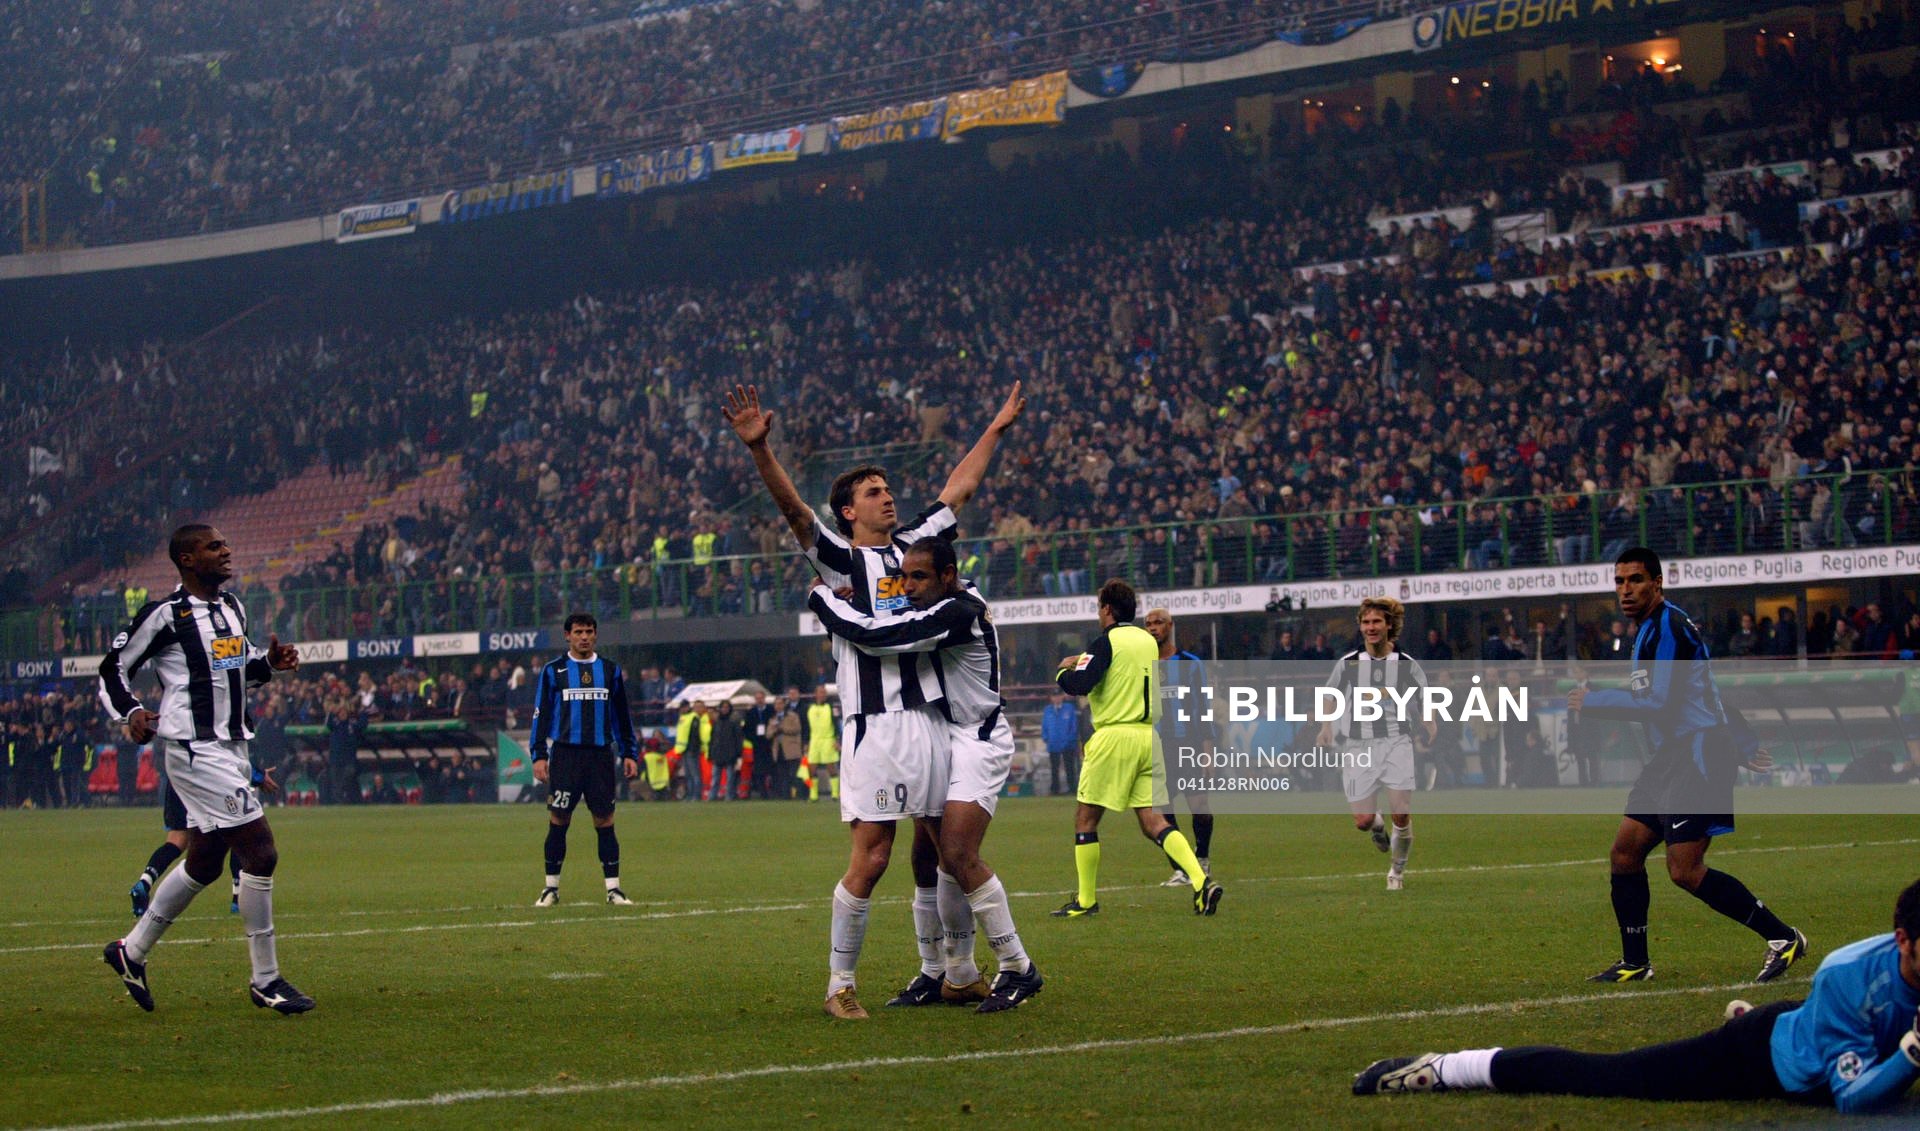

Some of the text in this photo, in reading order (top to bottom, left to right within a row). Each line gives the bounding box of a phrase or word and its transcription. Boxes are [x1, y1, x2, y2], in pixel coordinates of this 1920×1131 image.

[1445, 0, 1578, 41] NEBBIA
[1684, 557, 1803, 582] Regione Puglia
[1822, 552, 1888, 573] Regione
[877, 576, 906, 599] SK
[1344, 582, 1386, 600] Puglia
[1413, 580, 1440, 595] Una
[1447, 577, 1501, 595] regione
[1508, 572, 1555, 590] aperta
[1562, 569, 1598, 587] tutto
[1004, 602, 1043, 619] aperta
[1047, 601, 1078, 616] tutto
[1146, 588, 1242, 611] Regione Puglia
[212, 635, 243, 660] SKY
[357, 640, 402, 658] SONY
[489, 632, 538, 650] SONY
[17, 660, 54, 678] SONY
[213, 656, 244, 670] SPORT
[552, 790, 571, 808] 25
[895, 784, 908, 812] 9
